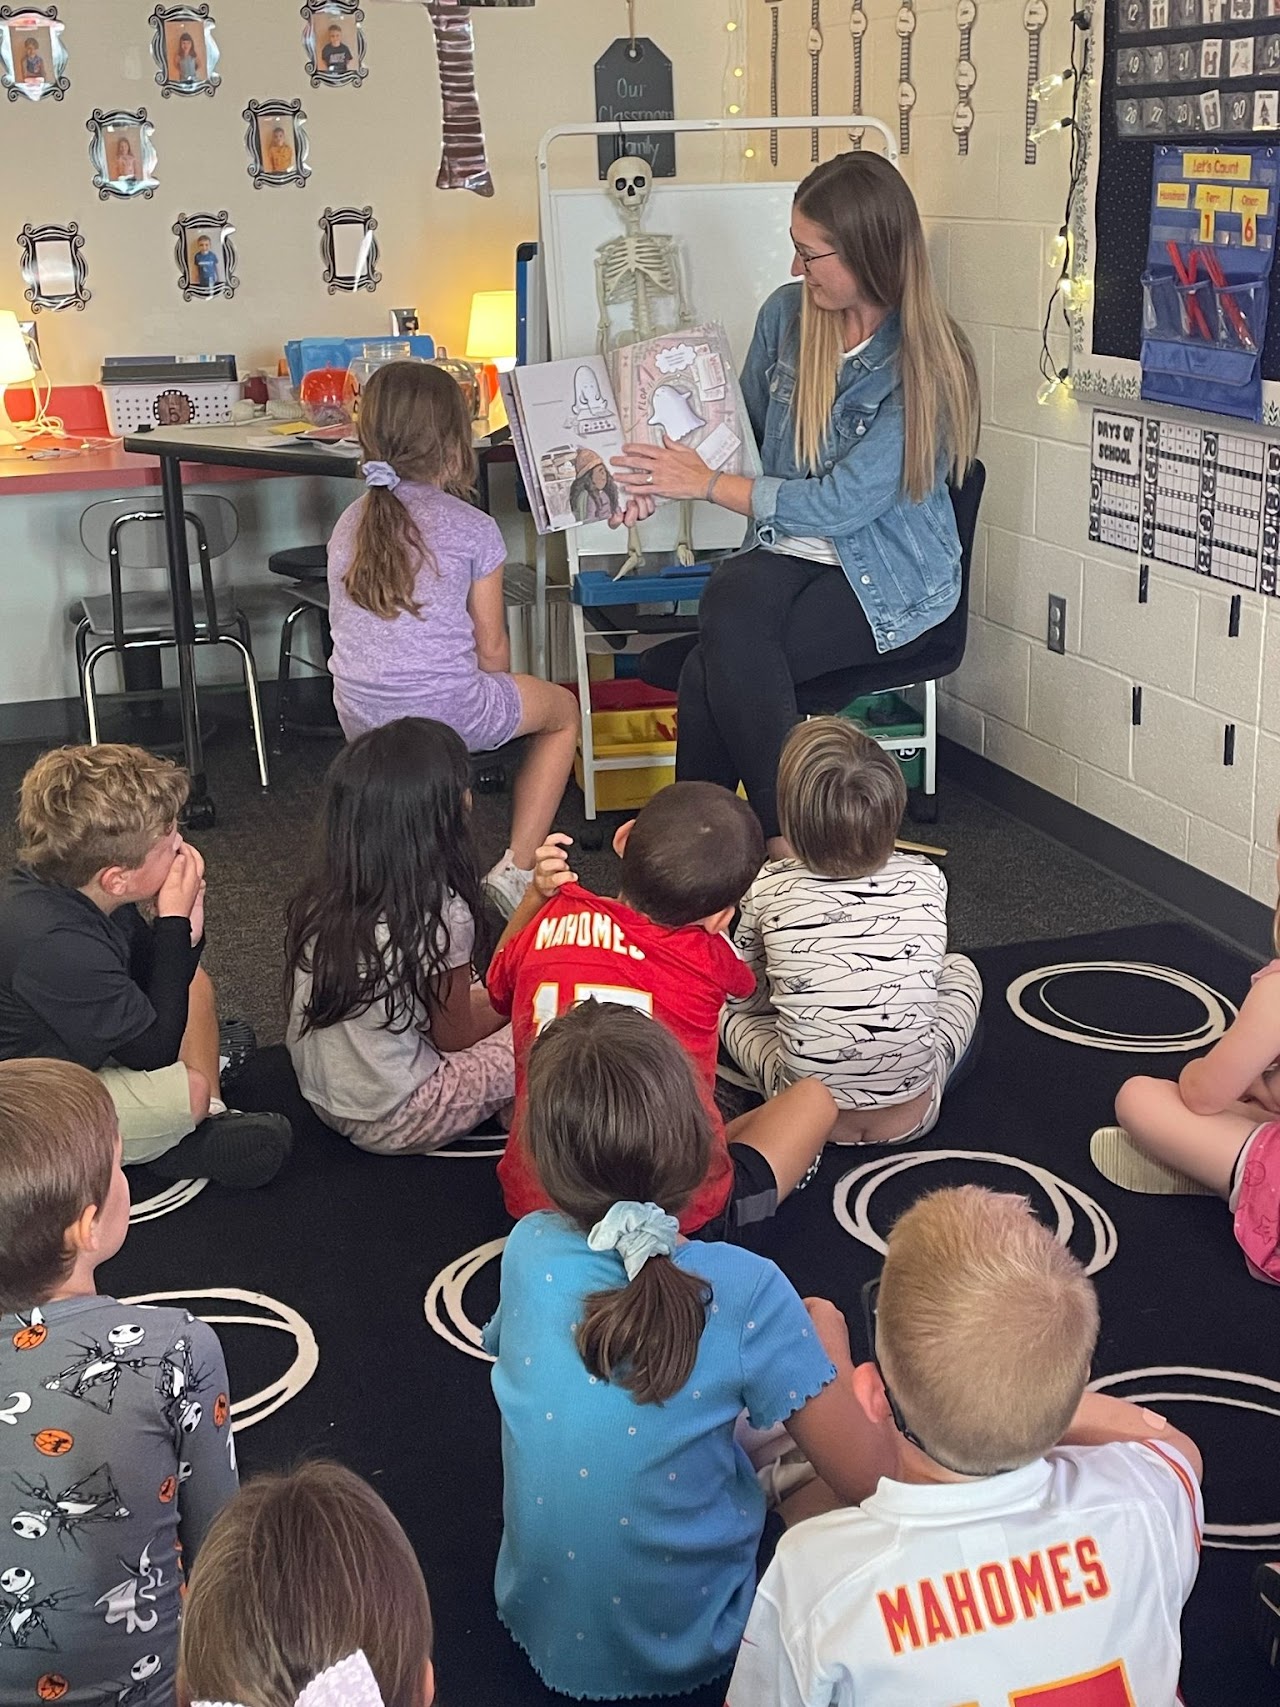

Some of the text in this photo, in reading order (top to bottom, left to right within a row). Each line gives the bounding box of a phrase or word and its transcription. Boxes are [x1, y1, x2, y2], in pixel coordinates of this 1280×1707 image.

[1127, 4, 1139, 21] 12
[1128, 56, 1140, 73] 19
[1178, 50, 1189, 71] 21
[616, 77, 645, 99] Our
[1232, 99, 1245, 121] 30
[1193, 159, 1240, 174] Let's Count
[1204, 214, 1211, 239] 1
[1244, 218, 1254, 243] 6
[168, 407, 180, 423] 5
[1097, 420, 1135, 443] DAYS OF
[1098, 444, 1131, 465] SCHOOL
[1203, 437, 1217, 457] 70
[876, 1534, 1111, 1656] MAHOMES
